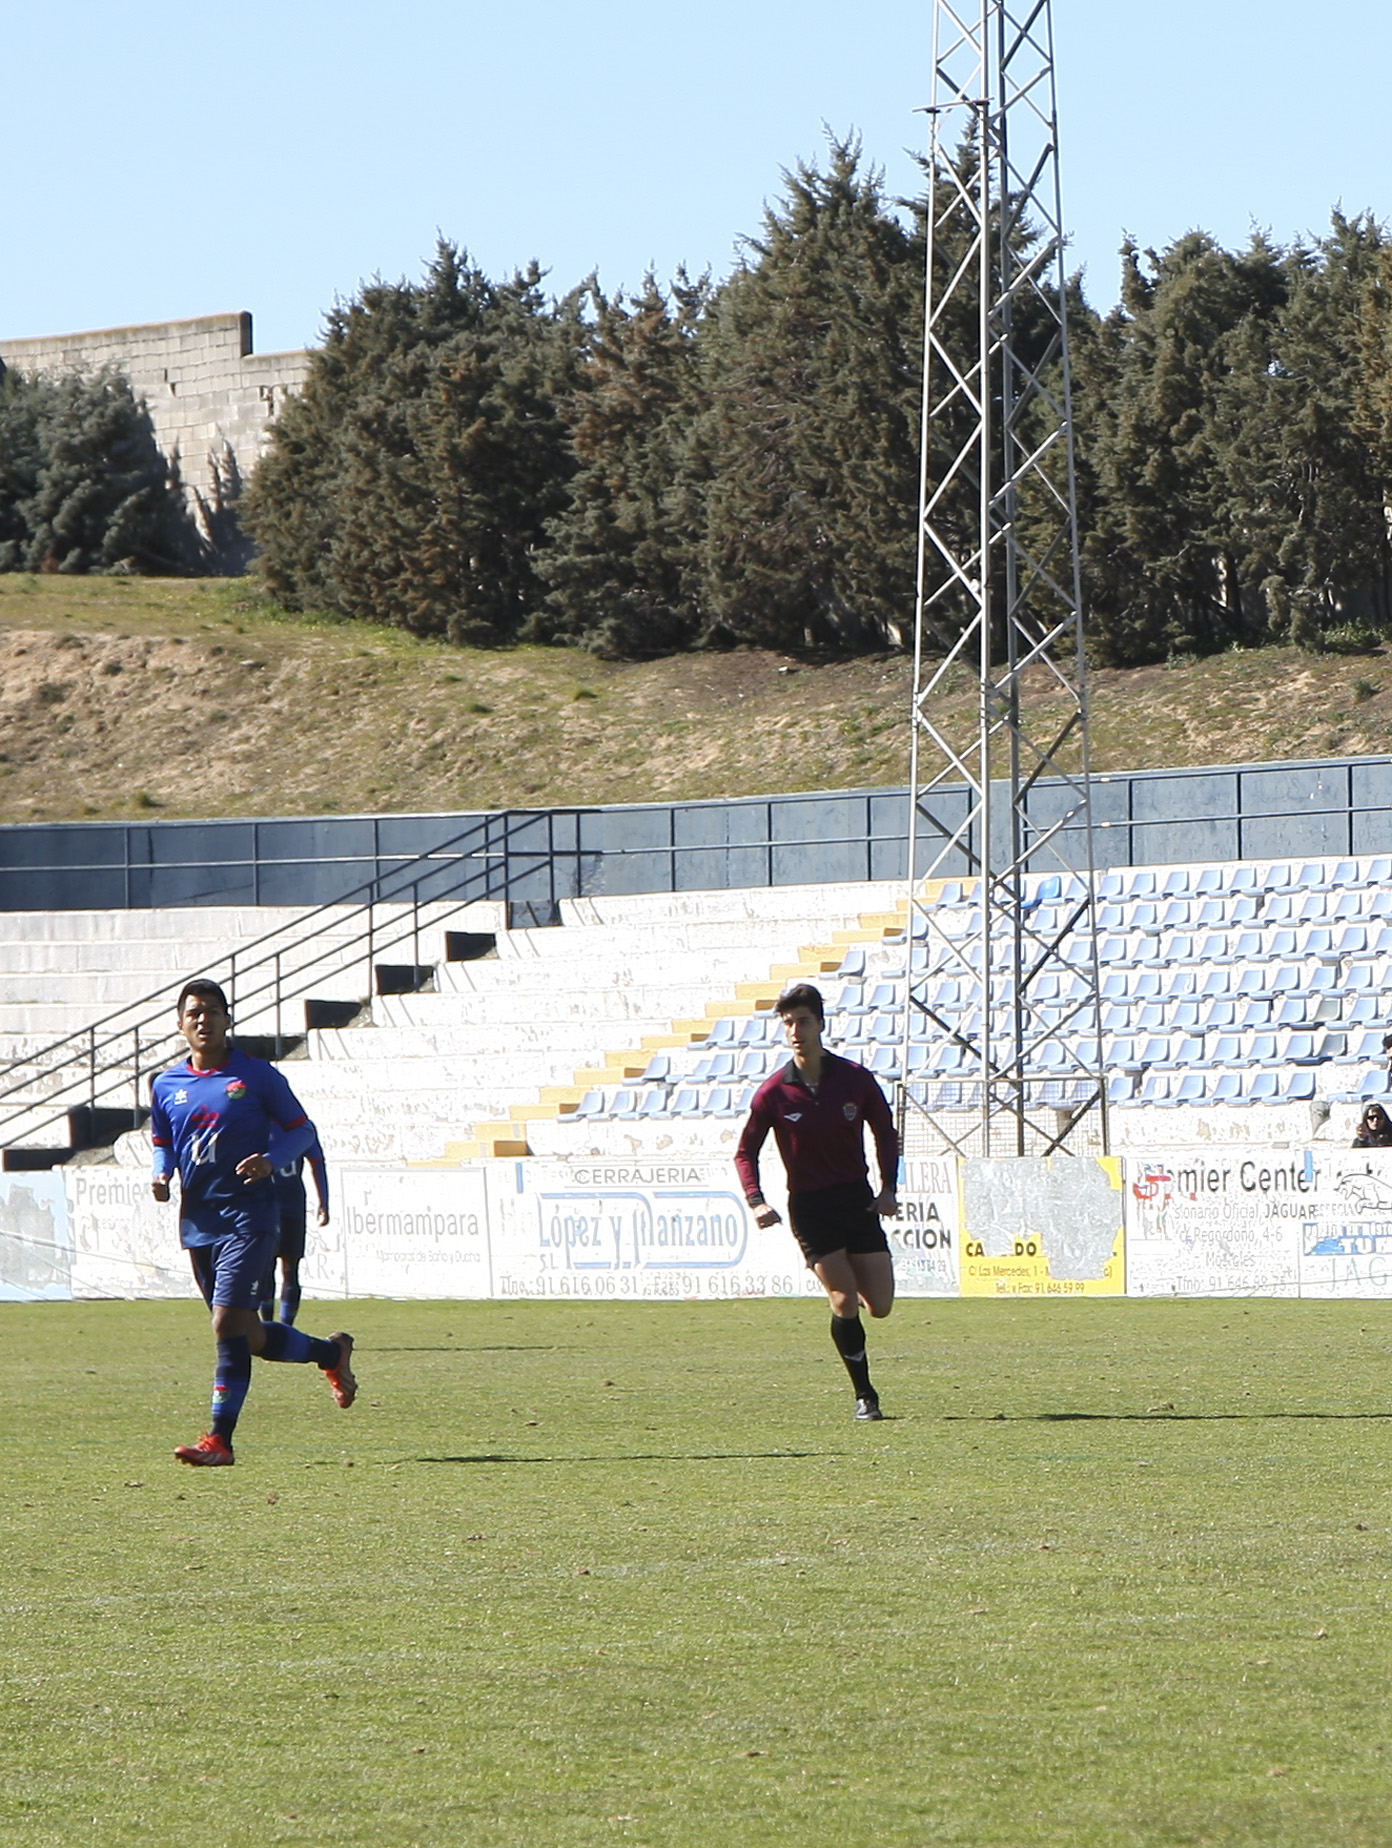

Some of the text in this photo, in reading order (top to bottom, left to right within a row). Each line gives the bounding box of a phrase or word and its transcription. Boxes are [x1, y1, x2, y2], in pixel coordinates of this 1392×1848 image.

[573, 1167, 704, 1185] CERRAJERIA
[1240, 1160, 1322, 1194] Center
[1264, 1202, 1317, 1220] JAGUAR
[346, 1206, 479, 1243] Ibermampara
